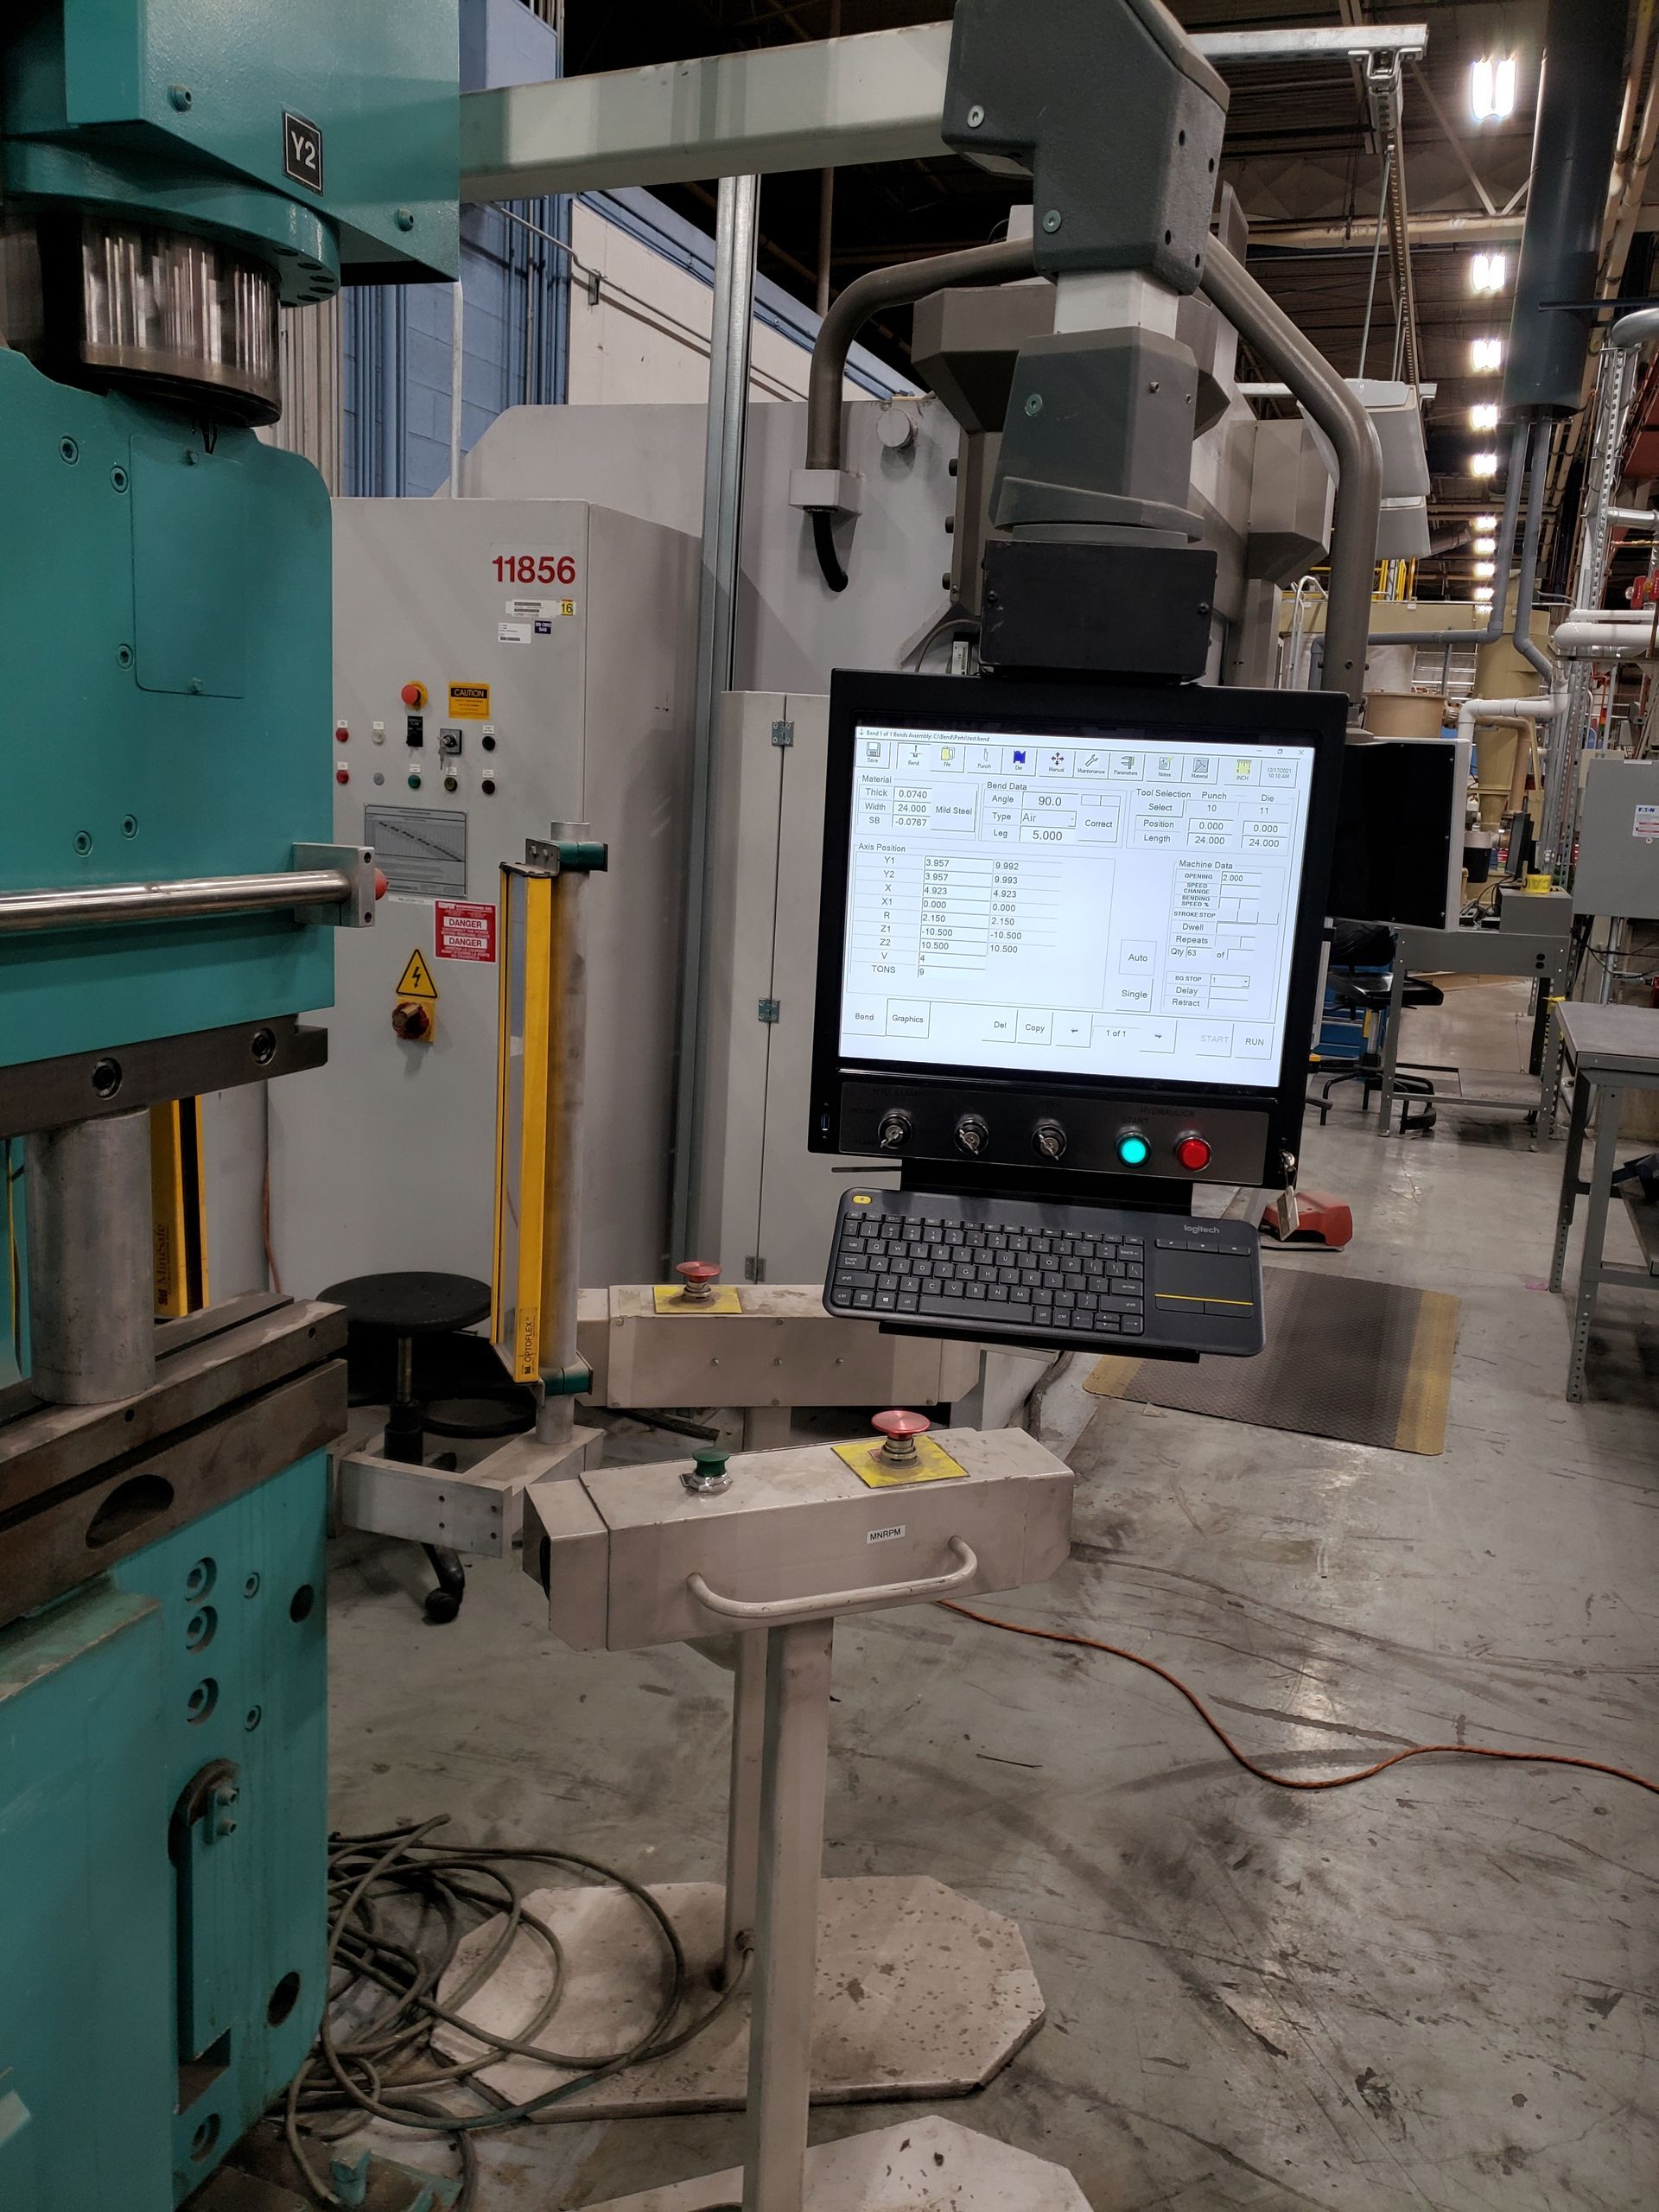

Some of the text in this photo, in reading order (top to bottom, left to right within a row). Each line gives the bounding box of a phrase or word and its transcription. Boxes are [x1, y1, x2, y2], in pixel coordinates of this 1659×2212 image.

[290, 130, 316, 170] Y2
[492, 556, 575, 584] 11856
[561, 603, 573, 613] 16
[861, 775, 892, 784] Material
[987, 782, 1007, 791] Bend
[866, 788, 927, 798] Thick 0.0740
[1136, 788, 1191, 798] Tool Selection
[992, 795, 1061, 806] Angle 90.0
[865, 803, 926, 813] Width 24.000
[992, 812, 1011, 822] Type
[1143, 820, 1174, 829] Position
[994, 830, 1062, 841] Leg 5.000
[1144, 835, 1279, 848] Length 24.000 24.000
[926, 859, 949, 868] 3.957
[995, 862, 1019, 871] 9.992
[1179, 860, 1212, 868] Machine
[925, 873, 948, 881] 3.957
[995, 876, 1018, 885] 9.993
[994, 890, 1017, 899] 4.923
[924, 900, 946, 909] 0.000
[449, 918, 481, 928] DANGER
[923, 914, 945, 923] 2.150
[992, 918, 1014, 926] 2.150
[449, 938, 481, 946] DANGER
[1176, 936, 1208, 944] Repeats
[922, 942, 949, 950] 10.500
[990, 945, 1017, 954] 10.500
[1171, 948, 1184, 957] Qty
[1128, 954, 1147, 963] Auto
[872, 965, 896, 974] TONS
[1122, 990, 1147, 999] Single
[1176, 987, 1198, 996] Delay
[892, 1014, 923, 1024] Graphics
[1025, 1024, 1045, 1033] Copy
[1184, 1224, 1220, 1234] logitech
[870, 1529, 900, 1541] MNRPM
